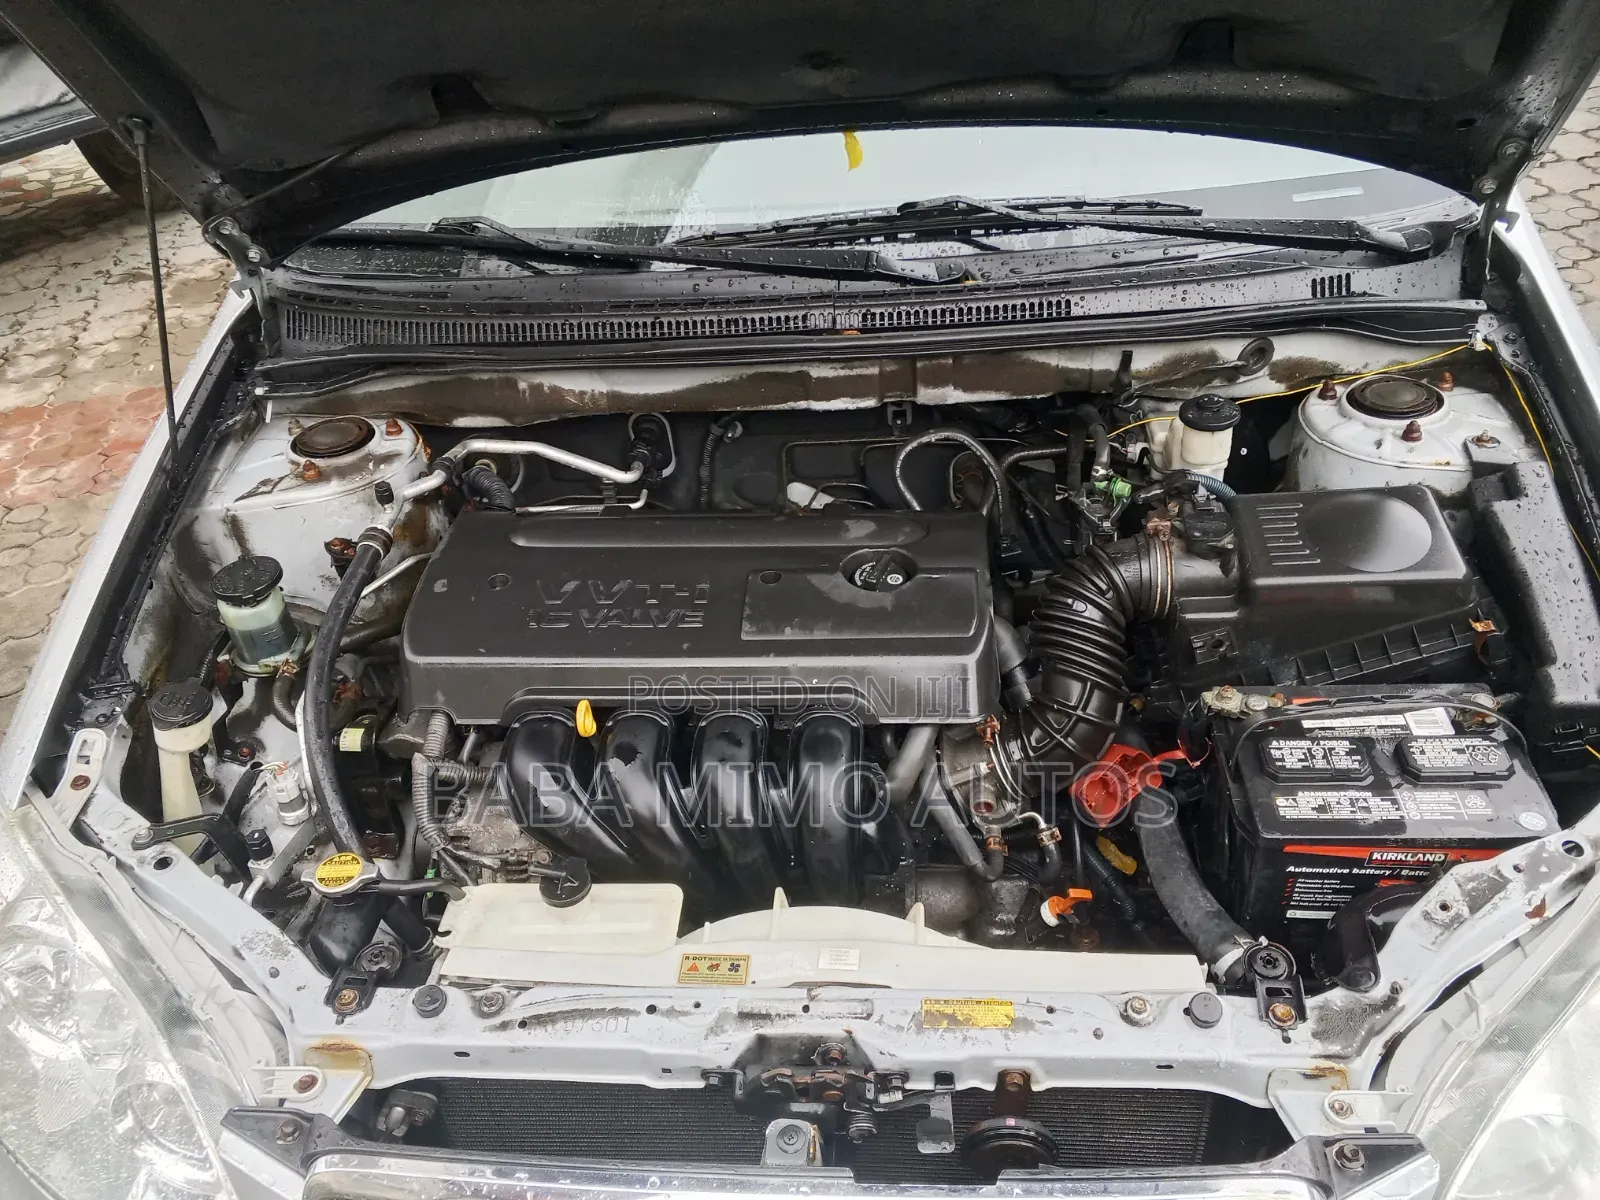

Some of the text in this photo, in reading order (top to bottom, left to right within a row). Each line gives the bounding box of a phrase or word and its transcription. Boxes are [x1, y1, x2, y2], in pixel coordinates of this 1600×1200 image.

[577, 608, 705, 628] VALVE
[1372, 852, 1445, 862] KIRKLAND
[1286, 865, 1350, 874] Automotive
[1352, 867, 1392, 876] battery
[1401, 869, 1430, 877] Batte
